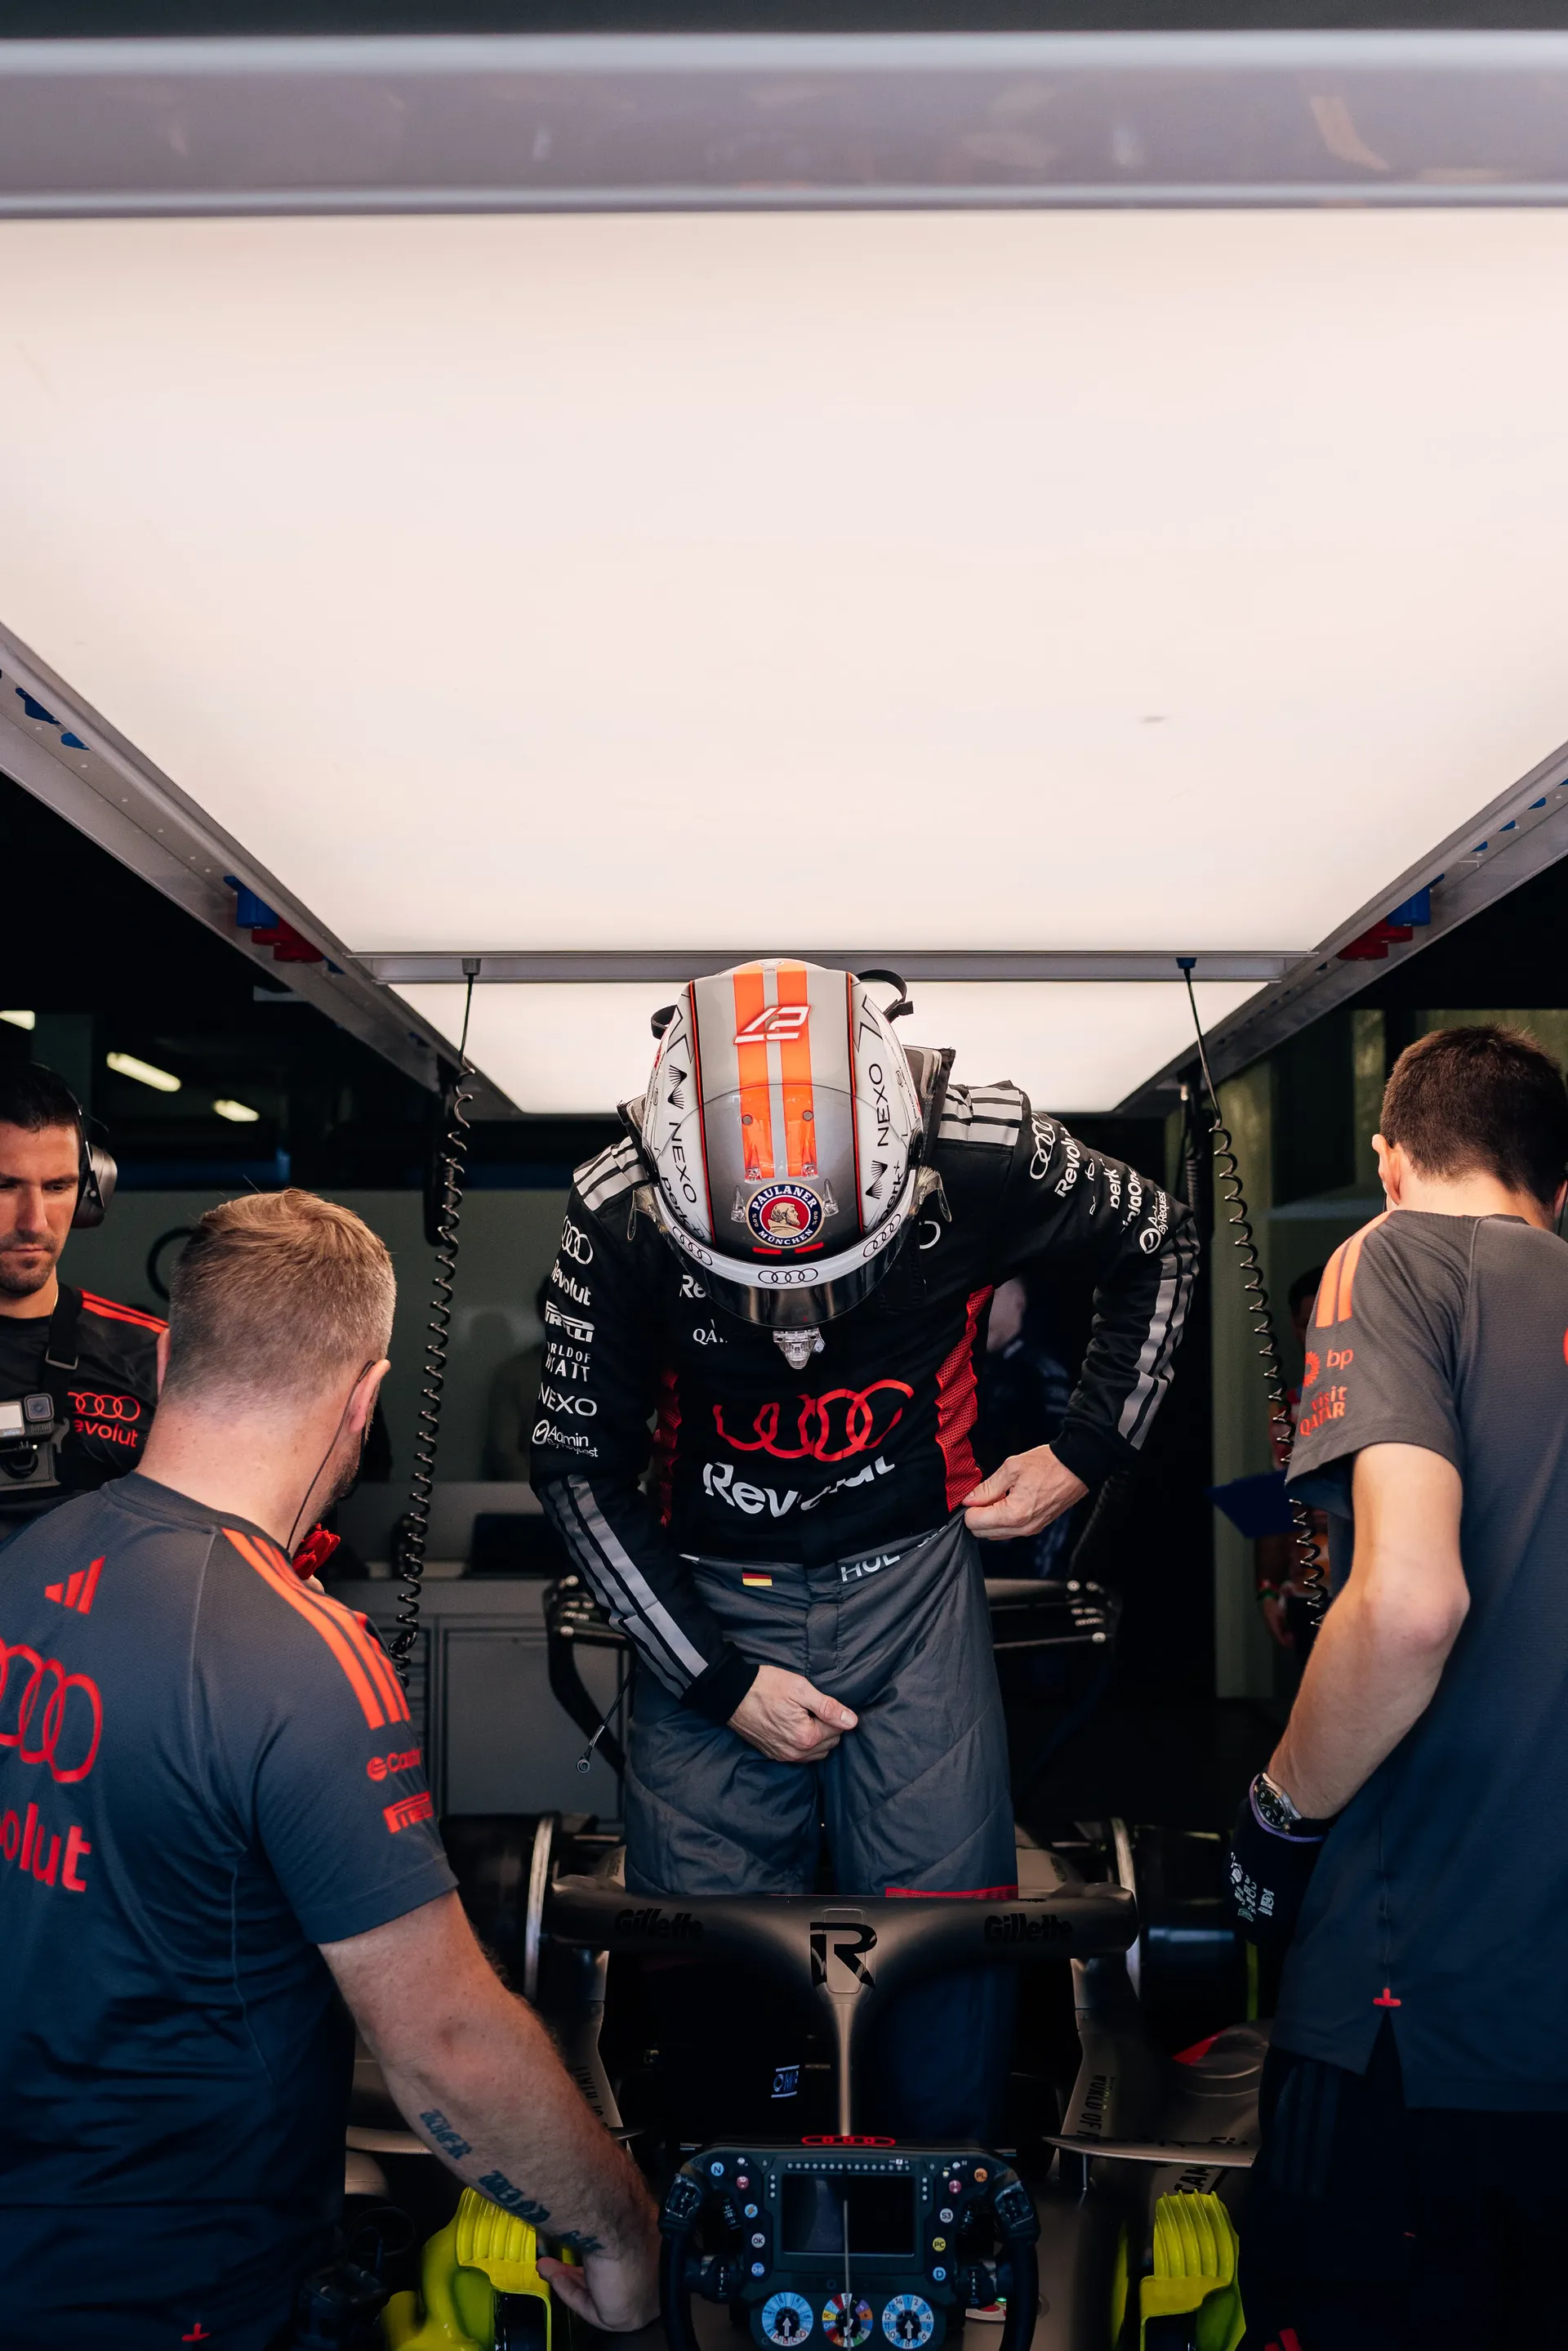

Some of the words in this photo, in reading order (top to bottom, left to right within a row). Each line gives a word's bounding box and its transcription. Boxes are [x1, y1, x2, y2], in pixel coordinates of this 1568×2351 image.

[869, 1063, 890, 1147] NEXO
[669, 1122, 697, 1204] NEXO
[751, 1185, 817, 1211] PAULANER
[759, 1229, 813, 1245] MÜNCHEN
[574, 1350, 590, 1363] OF
[1326, 1349, 1353, 1370] bp
[537, 1382, 597, 1416] NEXO
[1299, 1401, 1345, 1436] QATAR
[985, 1913, 1072, 1943] Gillette
[713, 2166, 721, 2174] N
[942, 2211, 951, 2219] S3
[937, 2270, 943, 2278] D
[888, 2331, 896, 2339] 10
